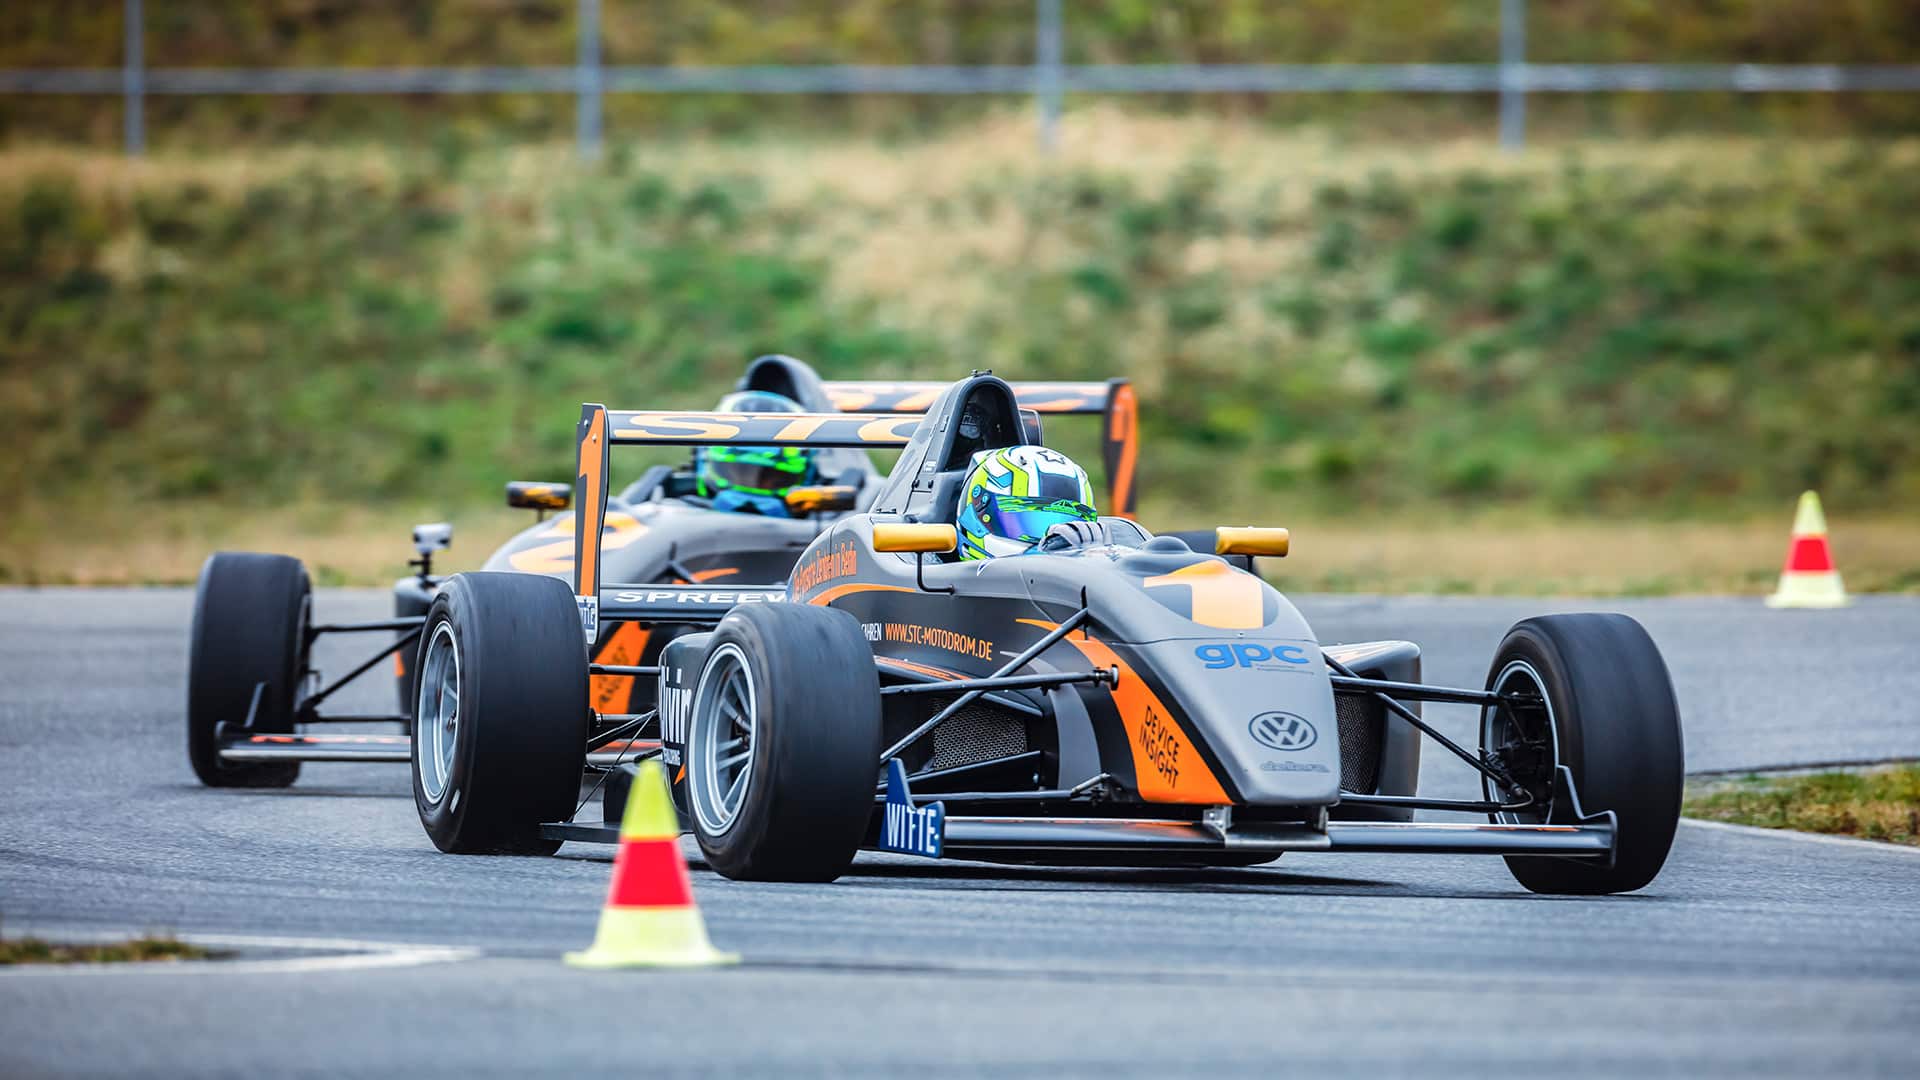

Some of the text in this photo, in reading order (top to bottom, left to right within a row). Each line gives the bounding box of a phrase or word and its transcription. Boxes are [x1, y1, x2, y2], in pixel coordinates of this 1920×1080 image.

[1144, 559, 1264, 630] 1
[885, 623, 993, 661] WWW.STC-MOTODROM.DE
[1195, 643, 1310, 669] gpc
[1139, 723, 1179, 789] INSIGHT
[1145, 705, 1179, 763] DEVICE
[886, 802, 937, 854] WITTE
